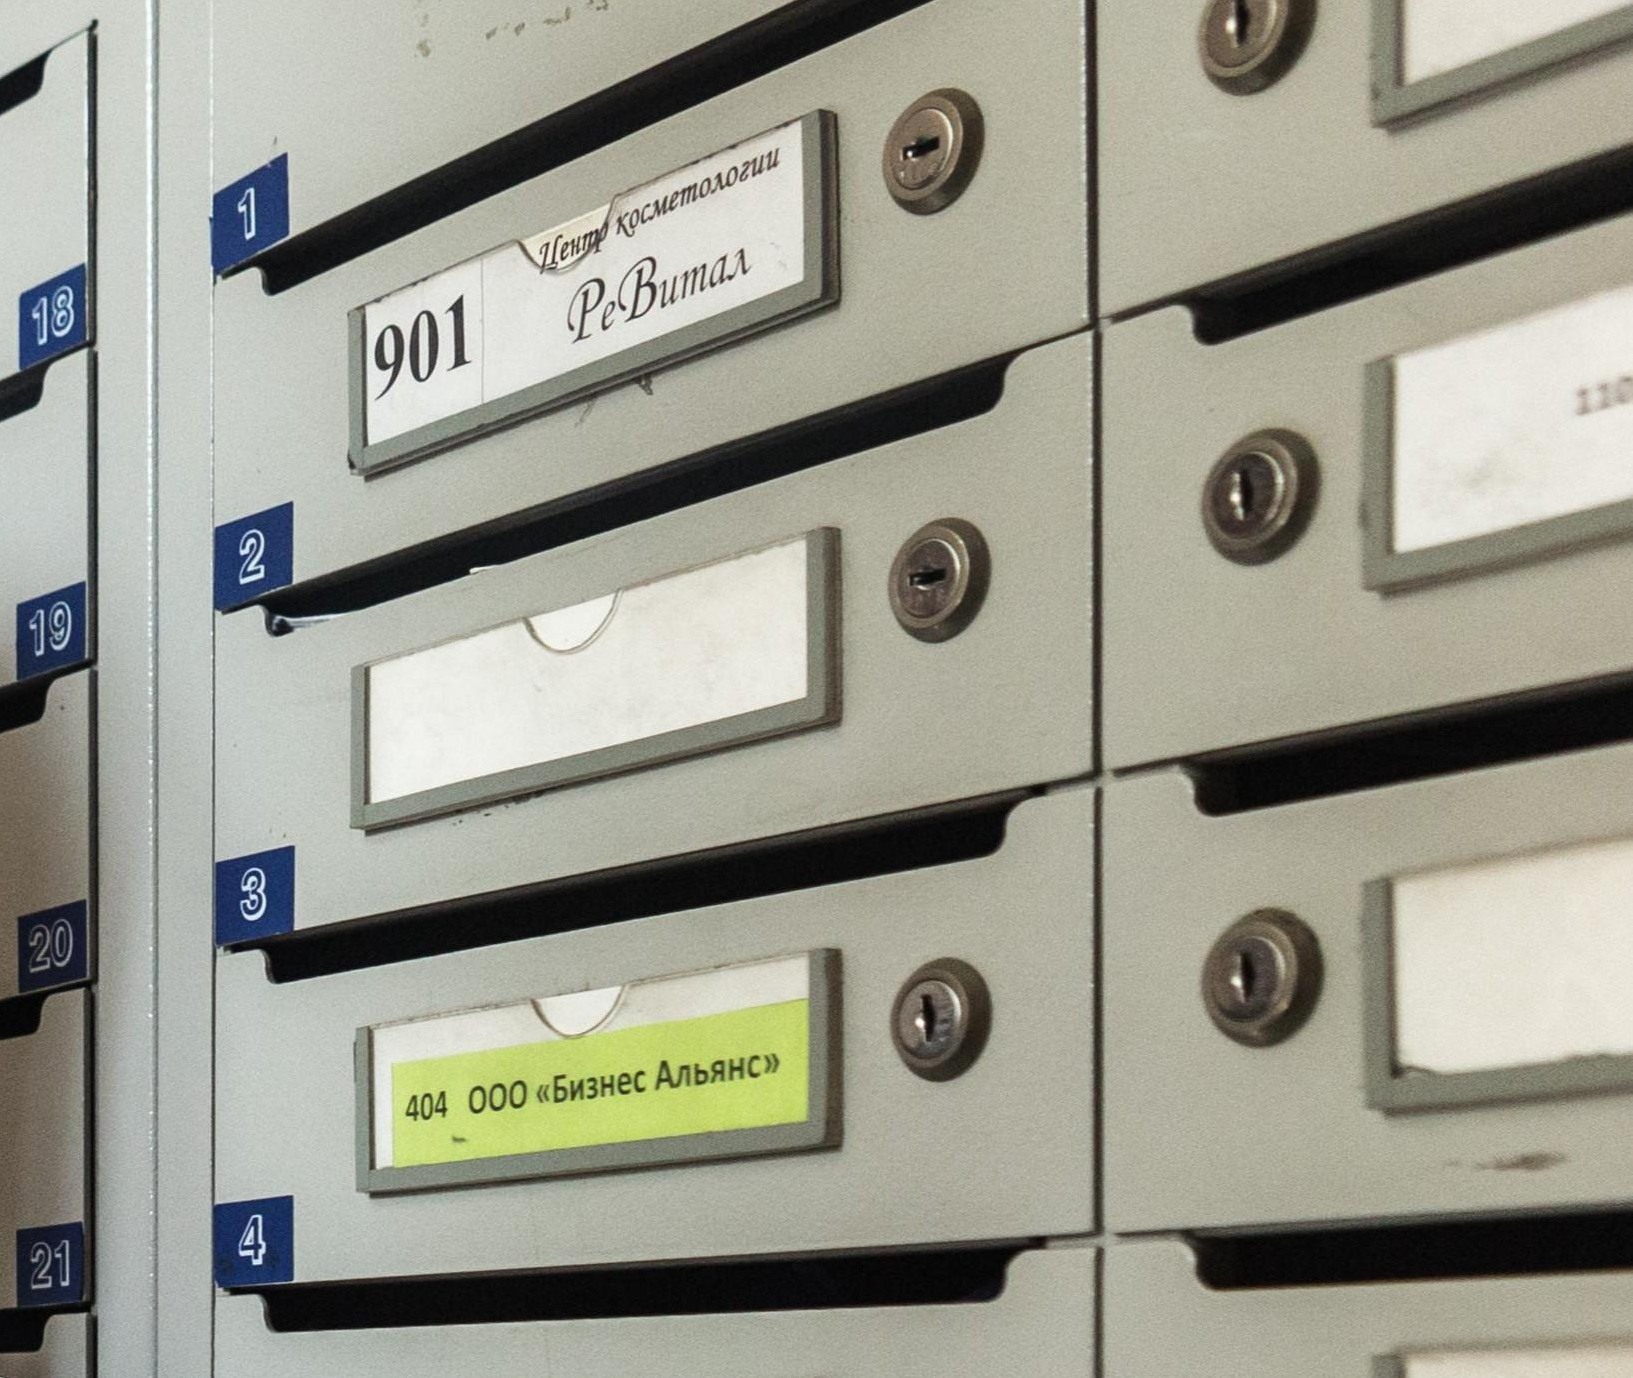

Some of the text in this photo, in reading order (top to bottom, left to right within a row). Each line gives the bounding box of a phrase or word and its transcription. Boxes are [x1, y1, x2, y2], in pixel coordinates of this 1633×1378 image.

[236, 187, 259, 241] 1
[538, 145, 782, 276] Центр косметологии
[30, 284, 75, 344] 18
[567, 244, 753, 345] РеВитал
[374, 294, 473, 402] 901
[238, 529, 266, 585] 2
[28, 601, 73, 655] 19
[239, 866, 267, 922] 3
[27, 916, 74, 970] 20
[405, 1051, 782, 1122] 404 ООО «Бизнес Альянс»
[27, 1238, 72, 1290] 21
[238, 1213, 267, 1266] 4
